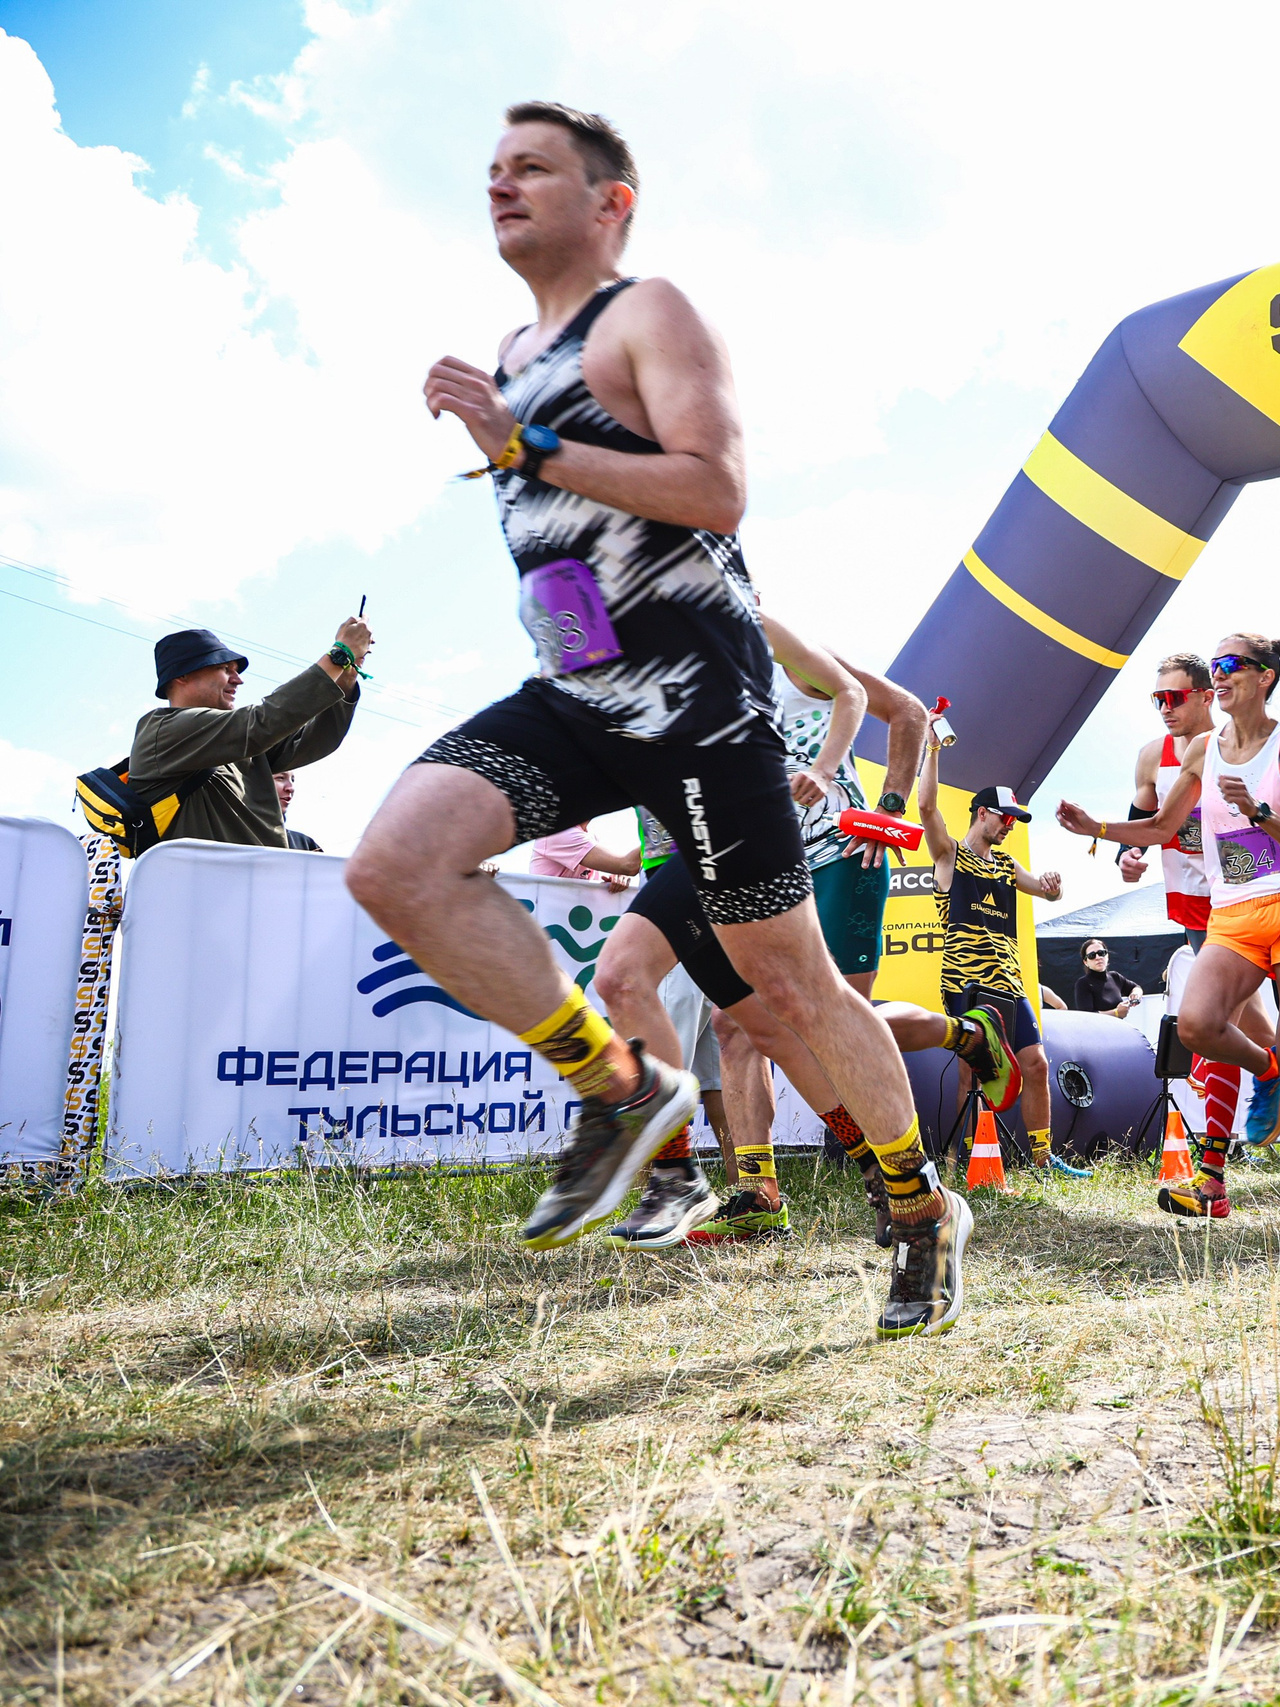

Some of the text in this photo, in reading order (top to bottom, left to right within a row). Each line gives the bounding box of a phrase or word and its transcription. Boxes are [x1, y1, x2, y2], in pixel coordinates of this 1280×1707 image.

[1226, 849, 1275, 877] 324
[216, 1045, 532, 1091] ФЕДЕРАЦИЯ
[287, 1089, 546, 1142] ТУЛЬСКОЙ
